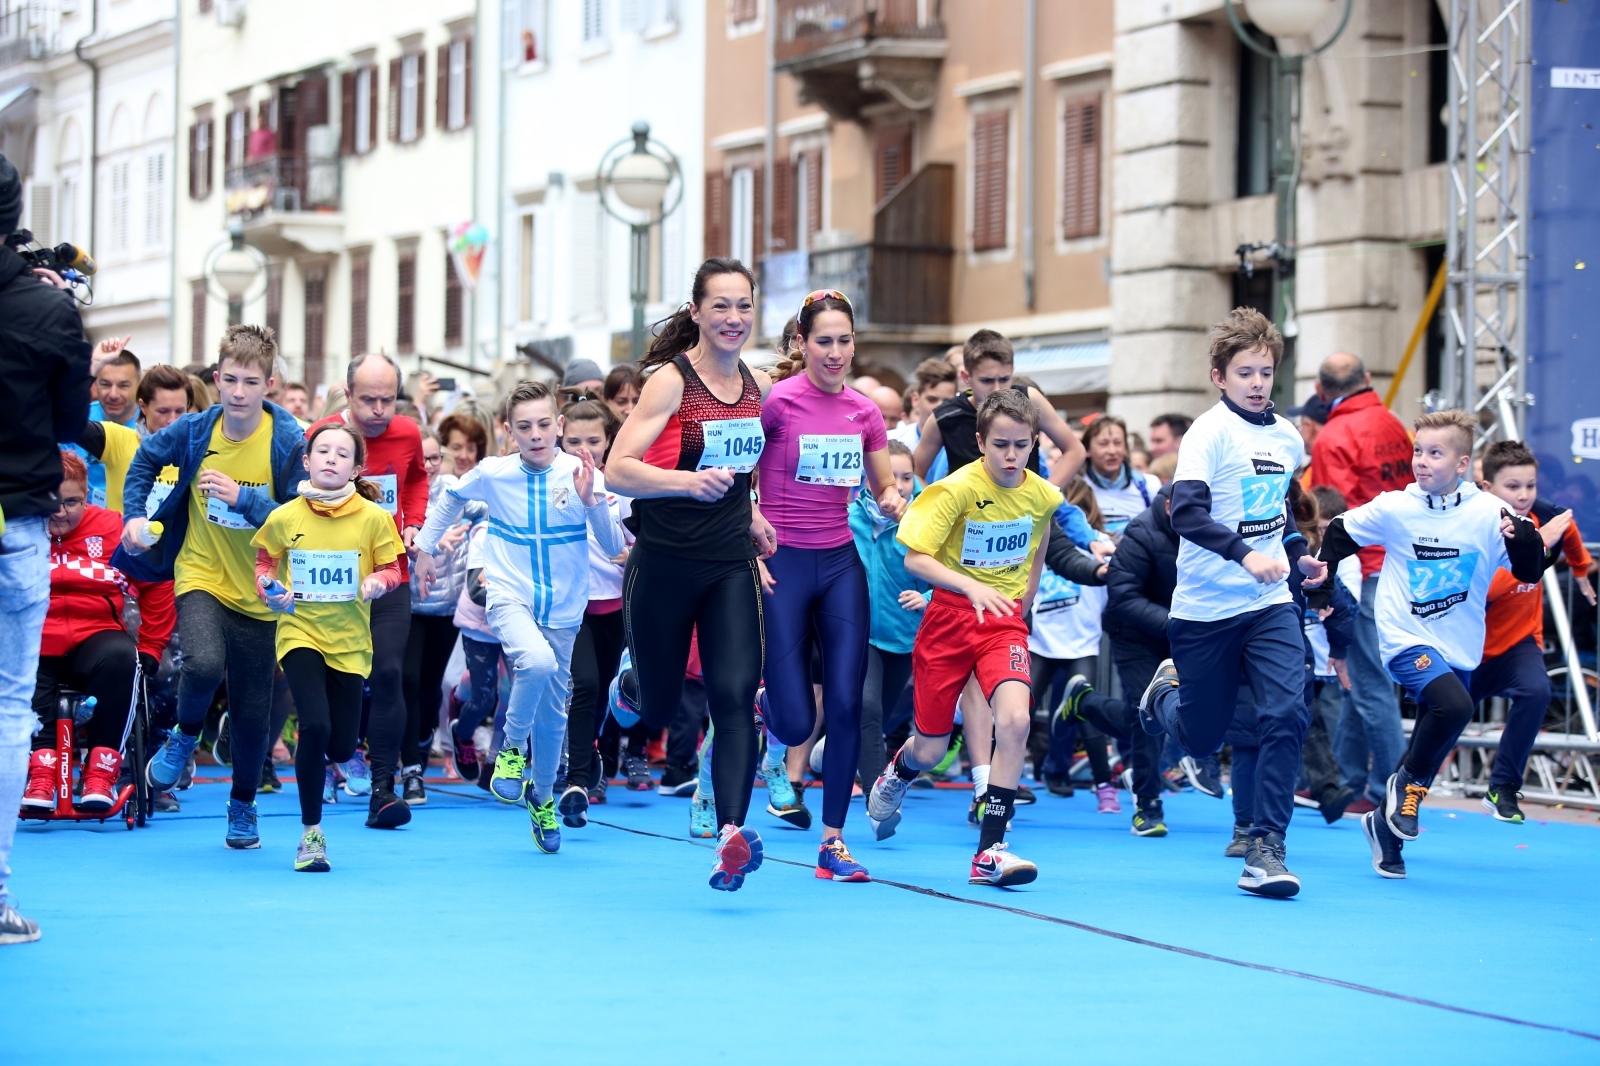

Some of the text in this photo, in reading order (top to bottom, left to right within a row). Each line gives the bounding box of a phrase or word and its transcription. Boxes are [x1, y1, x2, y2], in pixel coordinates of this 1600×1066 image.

[1582, 428, 1600, 448] H
[724, 436, 762, 457] 1045
[820, 451, 861, 470] 1123
[1381, 459, 1411, 481] RUN
[967, 527, 984, 536] RUN
[1241, 523, 1270, 534] HOMO
[985, 531, 1028, 553] 1080
[1417, 550, 1458, 558] #vjerujusebe
[308, 567, 353, 585] 1041
[1413, 559, 1468, 599] 23
[1437, 600, 1447, 609] SI
[96, 762, 115, 773] adidas
[984, 808, 1005, 817] SPORT
[985, 803, 1006, 811] INTER
